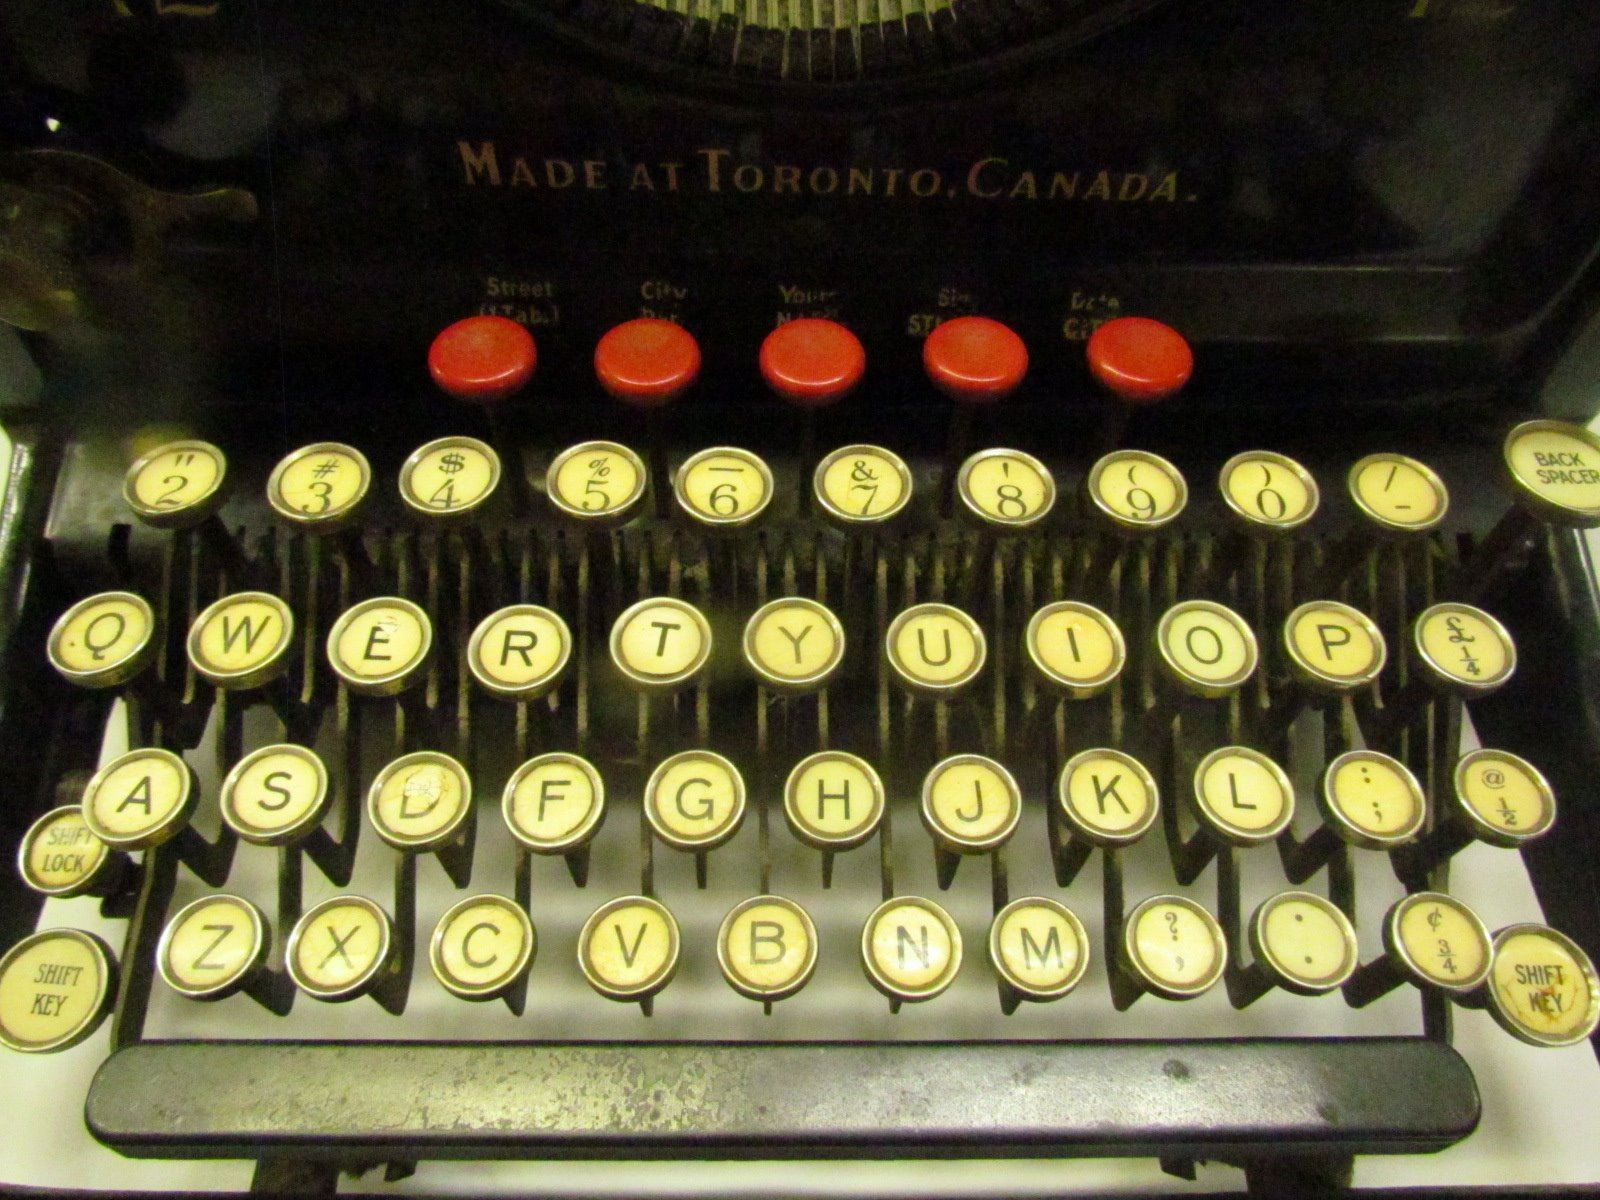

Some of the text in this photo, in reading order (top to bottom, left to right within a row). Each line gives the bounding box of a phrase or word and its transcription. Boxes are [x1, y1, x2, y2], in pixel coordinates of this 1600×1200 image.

[456, 138, 609, 189] MADE
[629, 160, 686, 193] AT
[486, 275, 554, 298] Street
[438, 452, 466, 474] $
[588, 457, 611, 477] %
[850, 459, 879, 482] &
[1534, 452, 1586, 467] BACK
[1536, 469, 1600, 485] SPACER
[155, 474, 188, 506] 2
[302, 481, 333, 515] 3
[429, 478, 460, 510] 4
[582, 479, 611, 512] 5
[708, 483, 739, 516] 6
[851, 484, 878, 515] 7
[996, 484, 1027, 518] 8
[1125, 487, 1157, 520] 9
[84, 611, 126, 661] Q
[221, 614, 271, 655] W
[362, 623, 396, 661] E
[499, 629, 538, 667] R
[650, 621, 681, 657] T
[777, 625, 813, 664] Y
[917, 627, 953, 667] U
[1066, 627, 1082, 663] I
[1185, 625, 1224, 665] O
[1316, 623, 1351, 662] P
[116, 775, 152, 815] A
[258, 771, 293, 812] S
[536, 779, 572, 822] F
[675, 777, 715, 821] G
[817, 778, 851, 821] H
[954, 779, 983, 823] J
[1091, 774, 1131, 816] K
[1228, 772, 1258, 811] L
[47, 825, 93, 845] SHIFT
[41, 853, 86, 873] LOCK
[191, 923, 234, 970] Z
[316, 924, 360, 970] X
[461, 921, 501, 969] C
[613, 922, 648, 970] V
[749, 919, 787, 966] B
[895, 924, 929, 970] N
[1020, 926, 1065, 970] M
[33, 963, 84, 987] SHIFT
[1514, 963, 1564, 986] SHIFT
[29, 993, 69, 1017] KEY
[1528, 991, 1564, 1013] KEY
